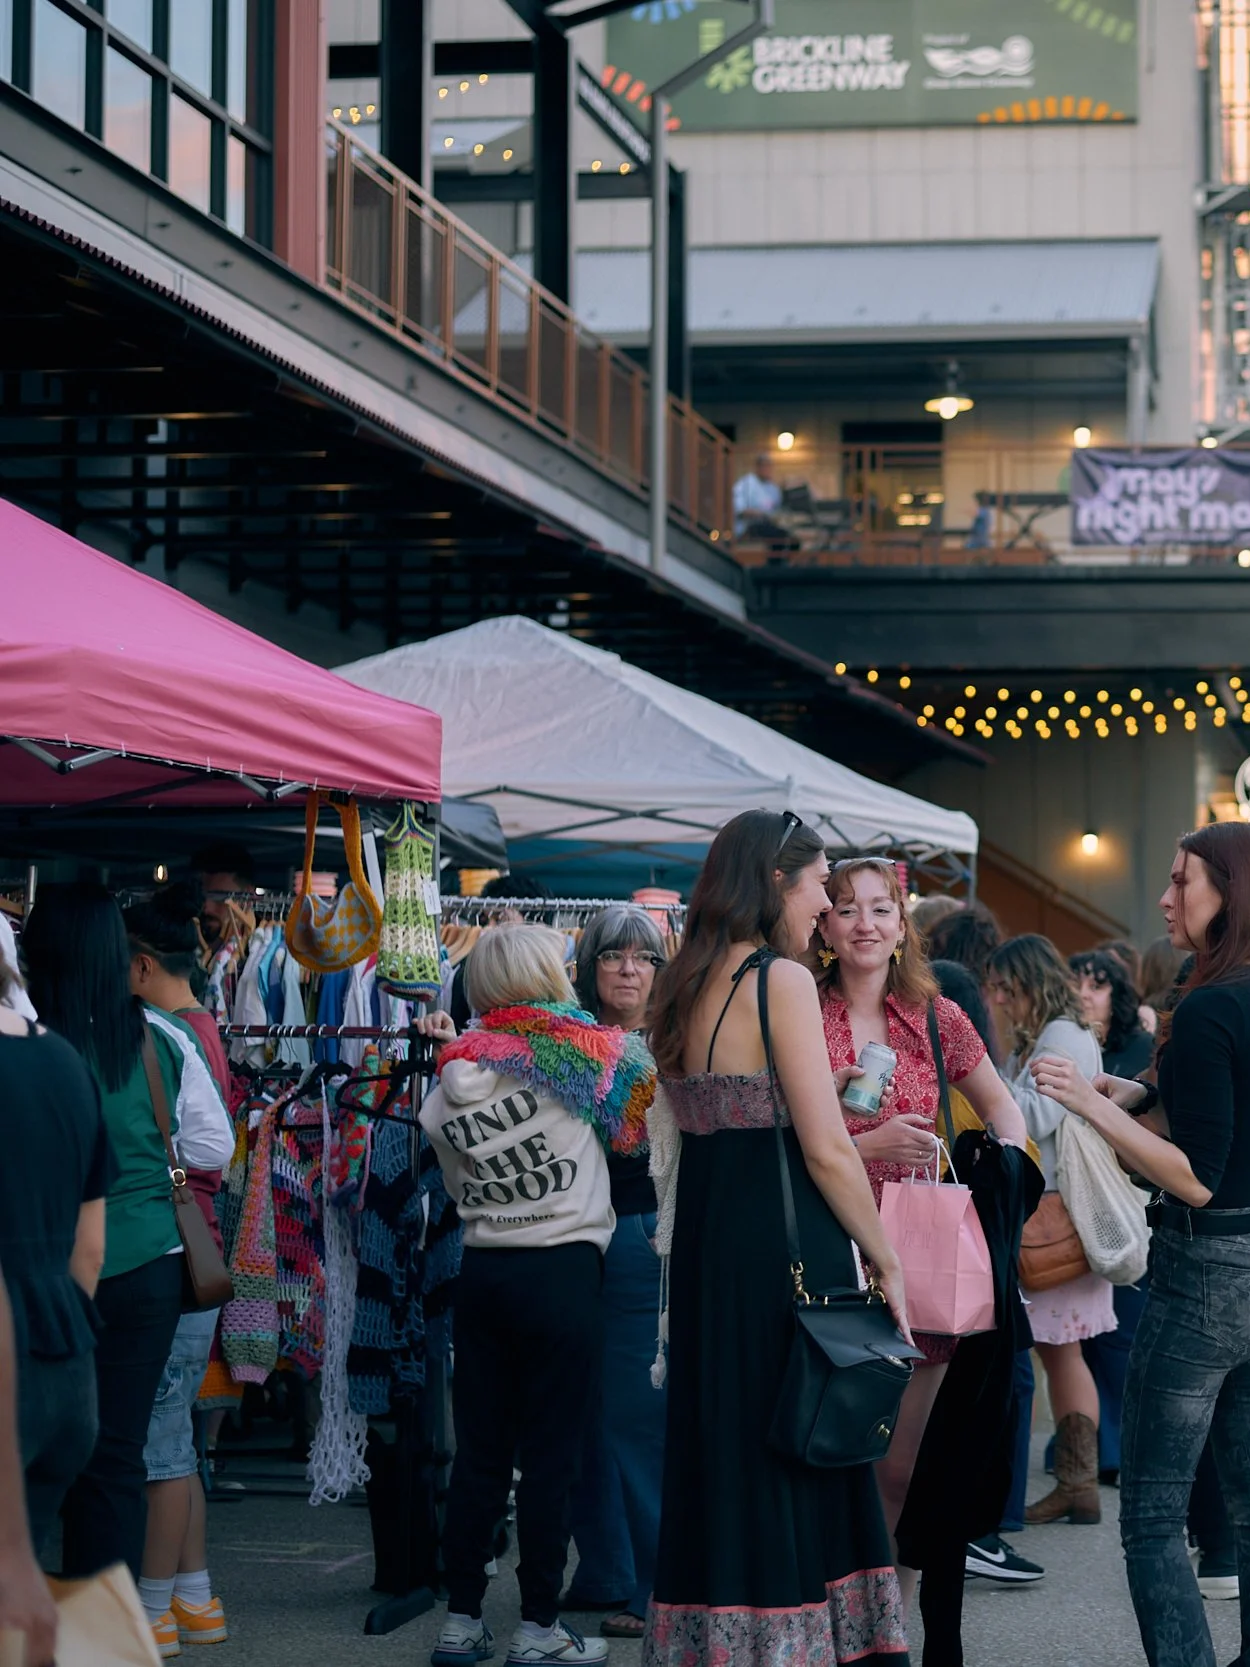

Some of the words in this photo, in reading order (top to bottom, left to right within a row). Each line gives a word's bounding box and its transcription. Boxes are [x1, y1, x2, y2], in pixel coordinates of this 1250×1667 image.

[753, 35, 893, 64] BRICKLINE
[753, 61, 910, 92] GREENWAY
[441, 1089, 538, 1152] FIND
[462, 1159, 577, 1207] GOOD
